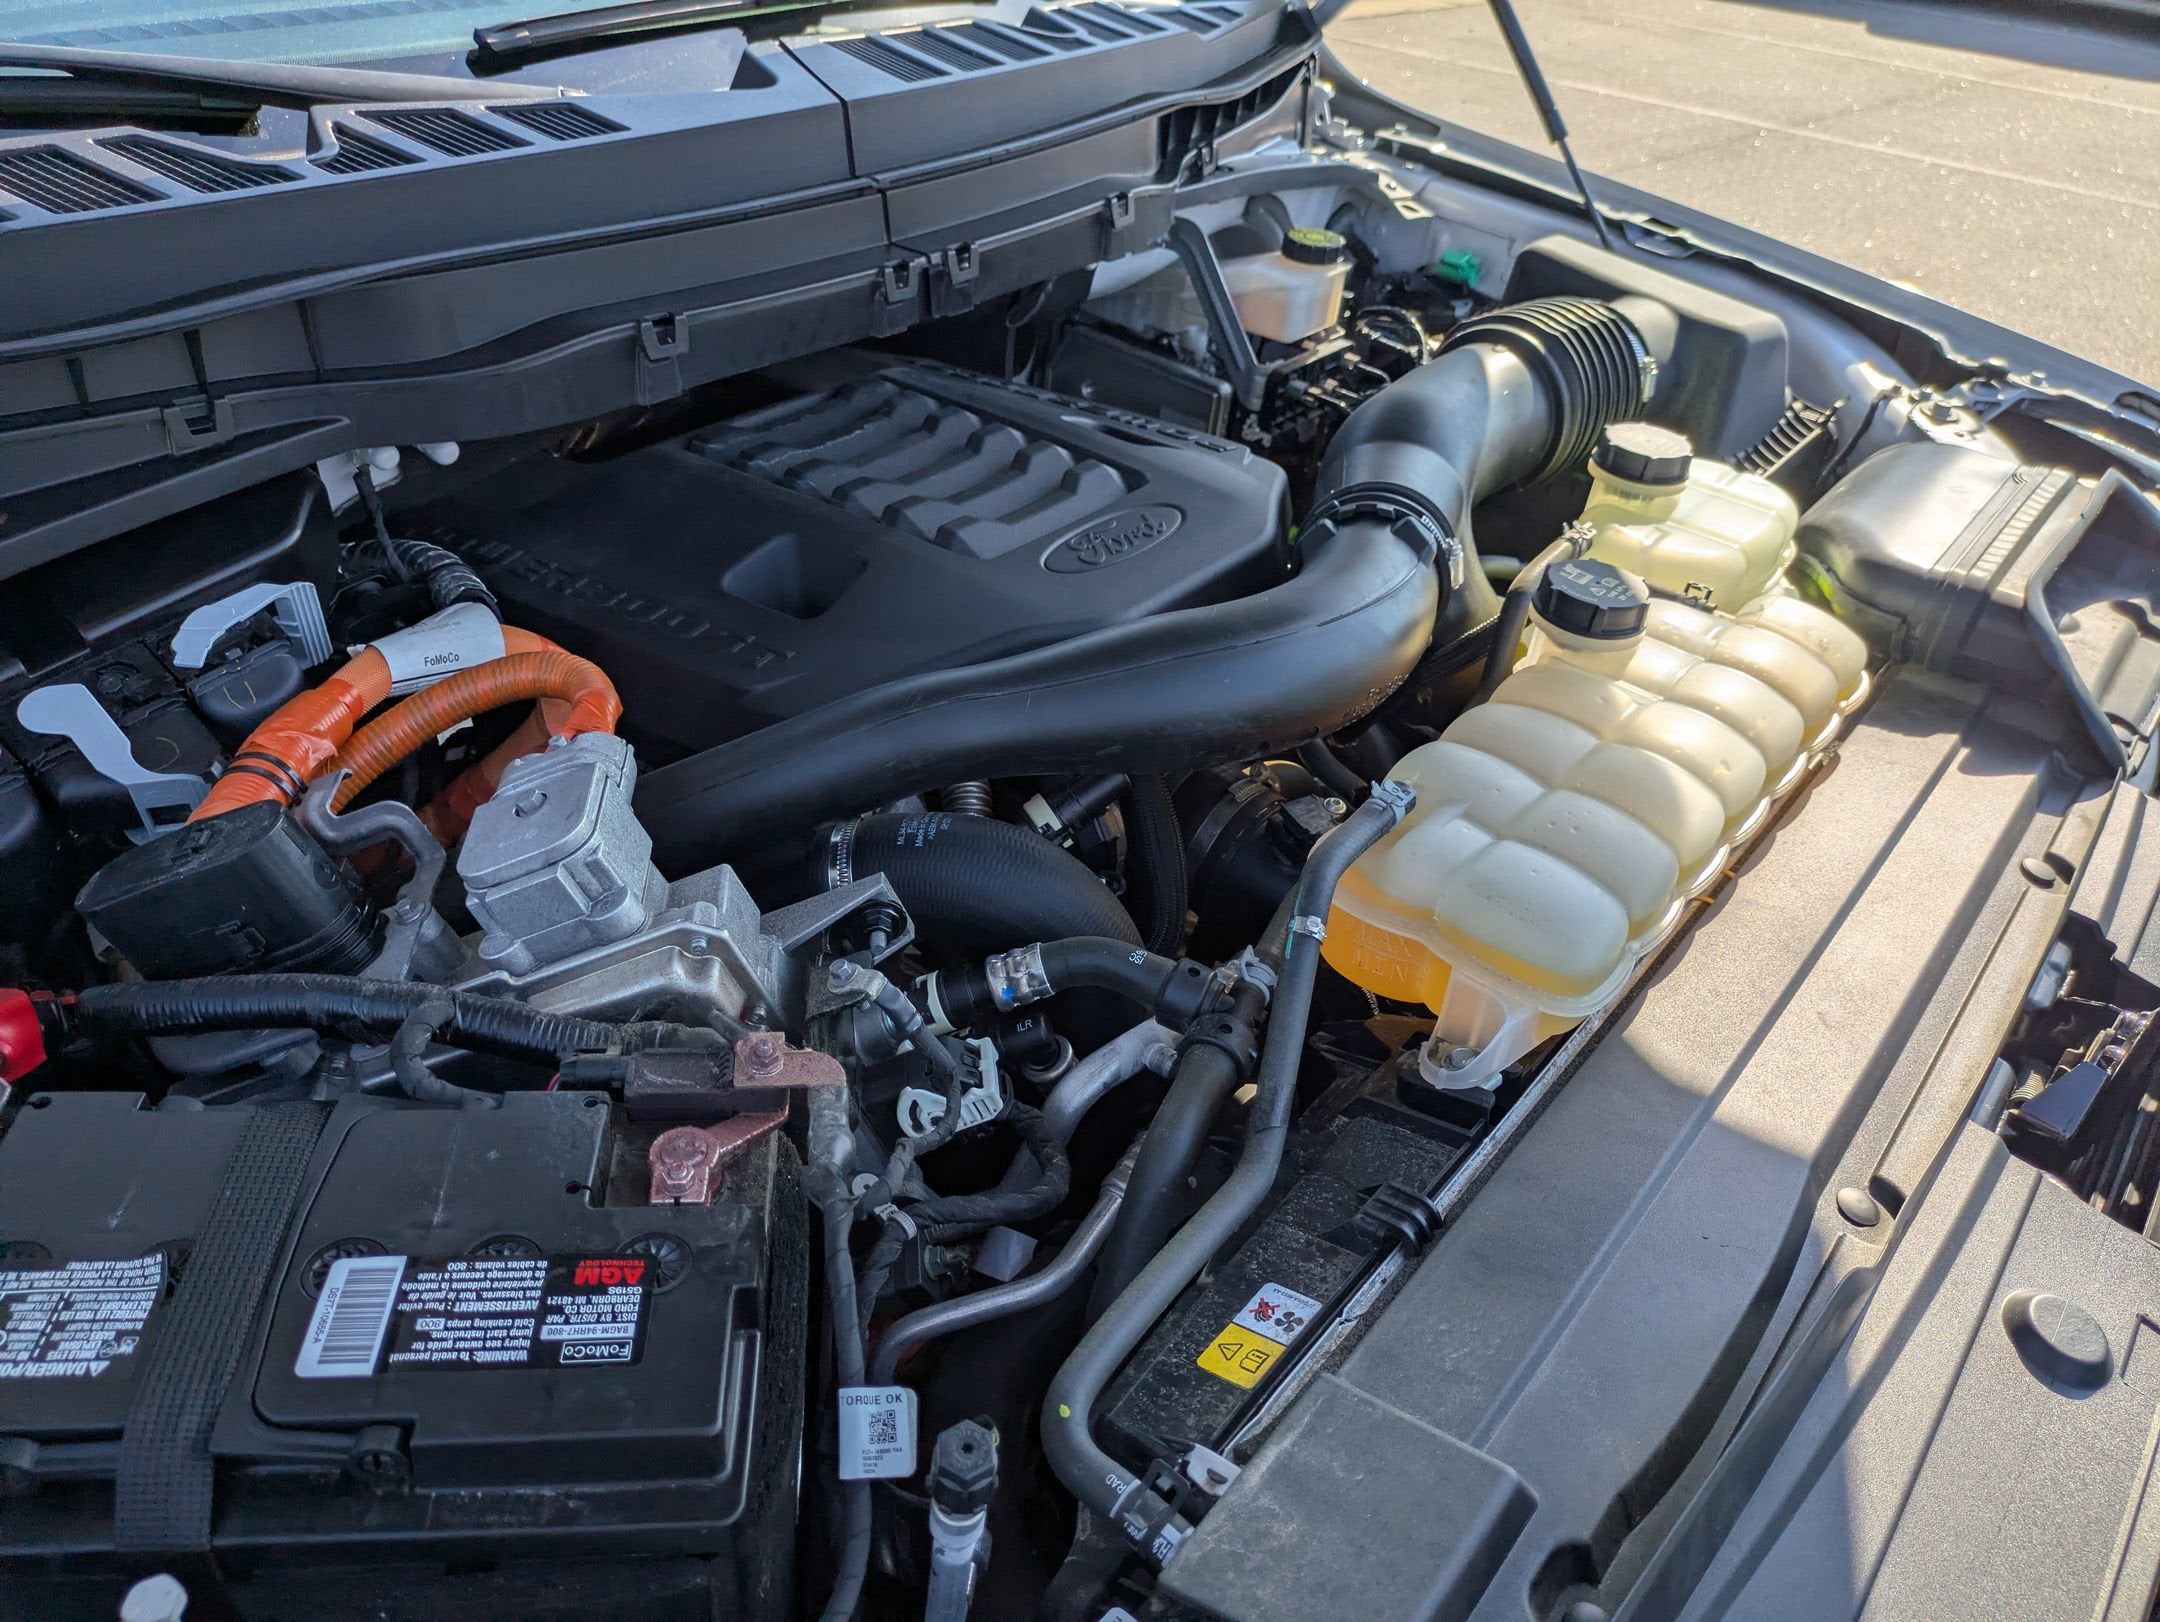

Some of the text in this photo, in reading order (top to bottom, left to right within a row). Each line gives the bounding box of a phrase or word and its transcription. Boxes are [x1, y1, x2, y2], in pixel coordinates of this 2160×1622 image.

[1066, 513, 1167, 567] Ford
[424, 652, 460, 667] FoMoCo
[1128, 953, 1145, 966] ISC
[1016, 1019, 1033, 1033] ILR
[104, 1262, 115, 1270] LA
[114, 1259, 142, 1270] OUVRIR
[142, 1256, 155, 1267] PAS
[447, 1262, 467, 1271] 800
[475, 1262, 505, 1271] volants
[507, 1261, 535, 1270] cables
[536, 1261, 547, 1270] de
[101, 1270, 112, 1278] LA
[111, 1270, 123, 1278] DE
[122, 1268, 144, 1278] HORS
[451, 1272, 485, 1280] secours
[486, 1270, 533, 1280] demarrage
[534, 1271, 545, 1279] de
[574, 1267, 645, 1286] AGM
[79, 1279, 104, 1287] REACH
[103, 1279, 118, 1287] THE
[129, 1277, 144, 1286] OUT
[144, 1275, 160, 1285] KEEP
[492, 1279, 544, 1289] proprietaire
[401, 1283, 439, 1291] methode
[441, 1282, 450, 1290] la
[607, 1286, 642, 1295] G519S
[407, 1291, 541, 1302] des blessures. Voir le guide du
[574, 1296, 587, 1304] MI
[589, 1294, 640, 1304] DEARBORN,
[99, 1301, 139, 1310] EXPLOSIFS
[137, 1301, 153, 1310] GAZ
[424, 1302, 445, 1310] Pour
[453, 1301, 539, 1312] AVERTISSEMENT
[562, 1304, 639, 1314] FORD MOTOR CO.
[59, 1311, 75, 1321] LES
[74, 1311, 95, 1320] YEUX
[95, 1311, 111, 1320] LES
[545, 1313, 637, 1323] DIST. BY DISTR. PAR
[420, 1318, 535, 1329] Cold cranking amps 800
[89, 1331, 116, 1341] GASES
[429, 1328, 533, 1340] jump start instructions.
[411, 1338, 530, 1351] injury see owner guide for
[564, 1344, 630, 1358] FoMoCo
[389, 1351, 528, 1363] WARNING: To avoid personal
[841, 1394, 903, 1406] TORQUE OK
[1105, 1474, 1127, 1494] RAD
